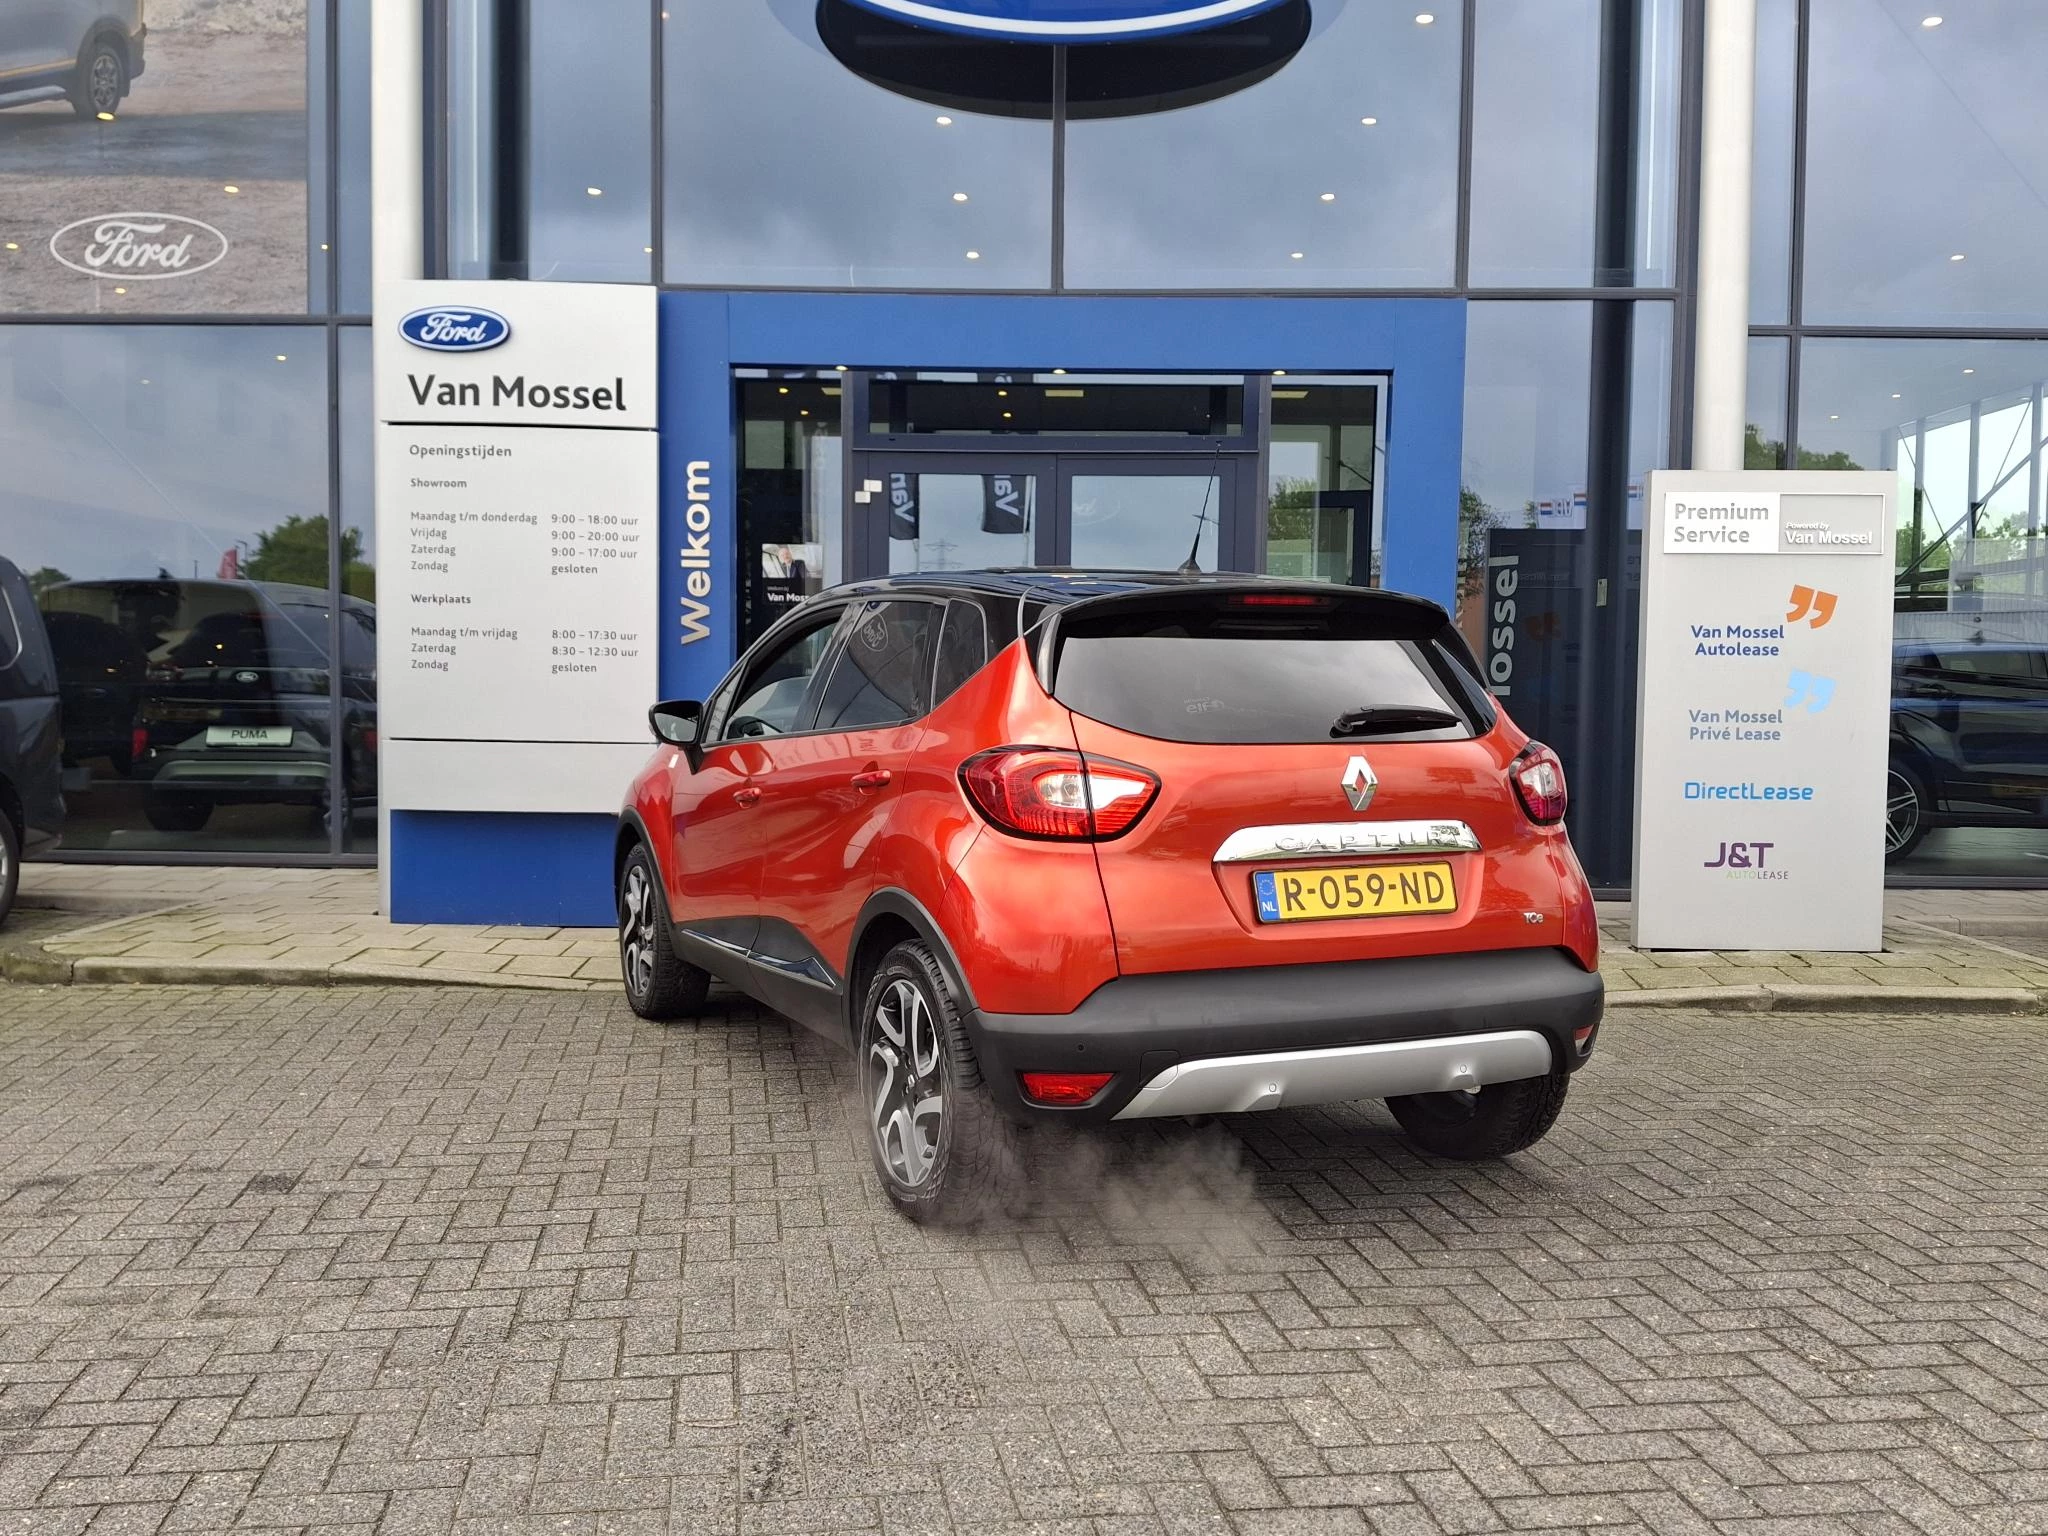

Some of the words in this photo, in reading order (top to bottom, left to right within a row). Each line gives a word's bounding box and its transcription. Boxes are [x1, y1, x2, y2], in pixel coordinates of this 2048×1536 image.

[84, 220, 194, 268] Ford
[420, 312, 487, 342] Ford
[406, 373, 481, 407] Van
[491, 374, 628, 412] Mossel
[408, 443, 513, 461] Openingstijden
[410, 477, 468, 489] Showroom
[410, 511, 457, 525] Maandag
[458, 511, 479, 522] t/m
[481, 512, 538, 526] donderdag
[1674, 502, 1769, 521] Premium
[551, 513, 576, 524] 9:00
[587, 514, 618, 526] 18:00
[620, 517, 639, 526] uur
[410, 527, 448, 541] Vrijdag
[551, 529, 576, 541] 9:00
[587, 530, 620, 542] 20:00
[621, 534, 641, 543] uur
[1673, 525, 1750, 544] Service
[1785, 530, 1814, 545] Van
[1818, 530, 1873, 545] Mossel
[410, 543, 457, 557] Zaterdag
[551, 546, 576, 558] 9:00
[587, 547, 617, 559] 17:00
[619, 551, 638, 560] uur
[680, 460, 711, 645] Welkom
[410, 560, 449, 574] Zondag
[551, 563, 598, 576] gesloten
[410, 593, 472, 607] Werkplaats
[767, 593, 785, 602] Van
[1489, 554, 1520, 696] ossel
[1690, 624, 1722, 639] Van
[1726, 624, 1785, 640] Mossel
[410, 626, 457, 640] Maandag
[459, 626, 479, 638] t/m
[481, 627, 519, 641] vrijdag
[551, 629, 577, 640] 8:00
[587, 630, 617, 641] 17:30
[619, 633, 638, 641] uur
[410, 642, 457, 656] Zaterdag
[551, 645, 577, 656] 8:30
[587, 646, 618, 657] 12:30
[620, 649, 639, 657] uur
[1694, 641, 1780, 657] Autolease
[410, 658, 449, 673] Zondag
[551, 661, 598, 675] gesloten
[1688, 709, 1721, 724] Van
[1724, 708, 1783, 724] Mossel
[231, 729, 268, 739] PUMA
[1689, 725, 1732, 741] Privé
[1735, 726, 1782, 741] Lease
[1684, 781, 1814, 801] DirectLease
[1703, 841, 1775, 869] J&T
[1726, 870, 1789, 880] AUTOLEASE
[1283, 871, 1444, 911] R-059-ND
[1262, 902, 1277, 912] NL
